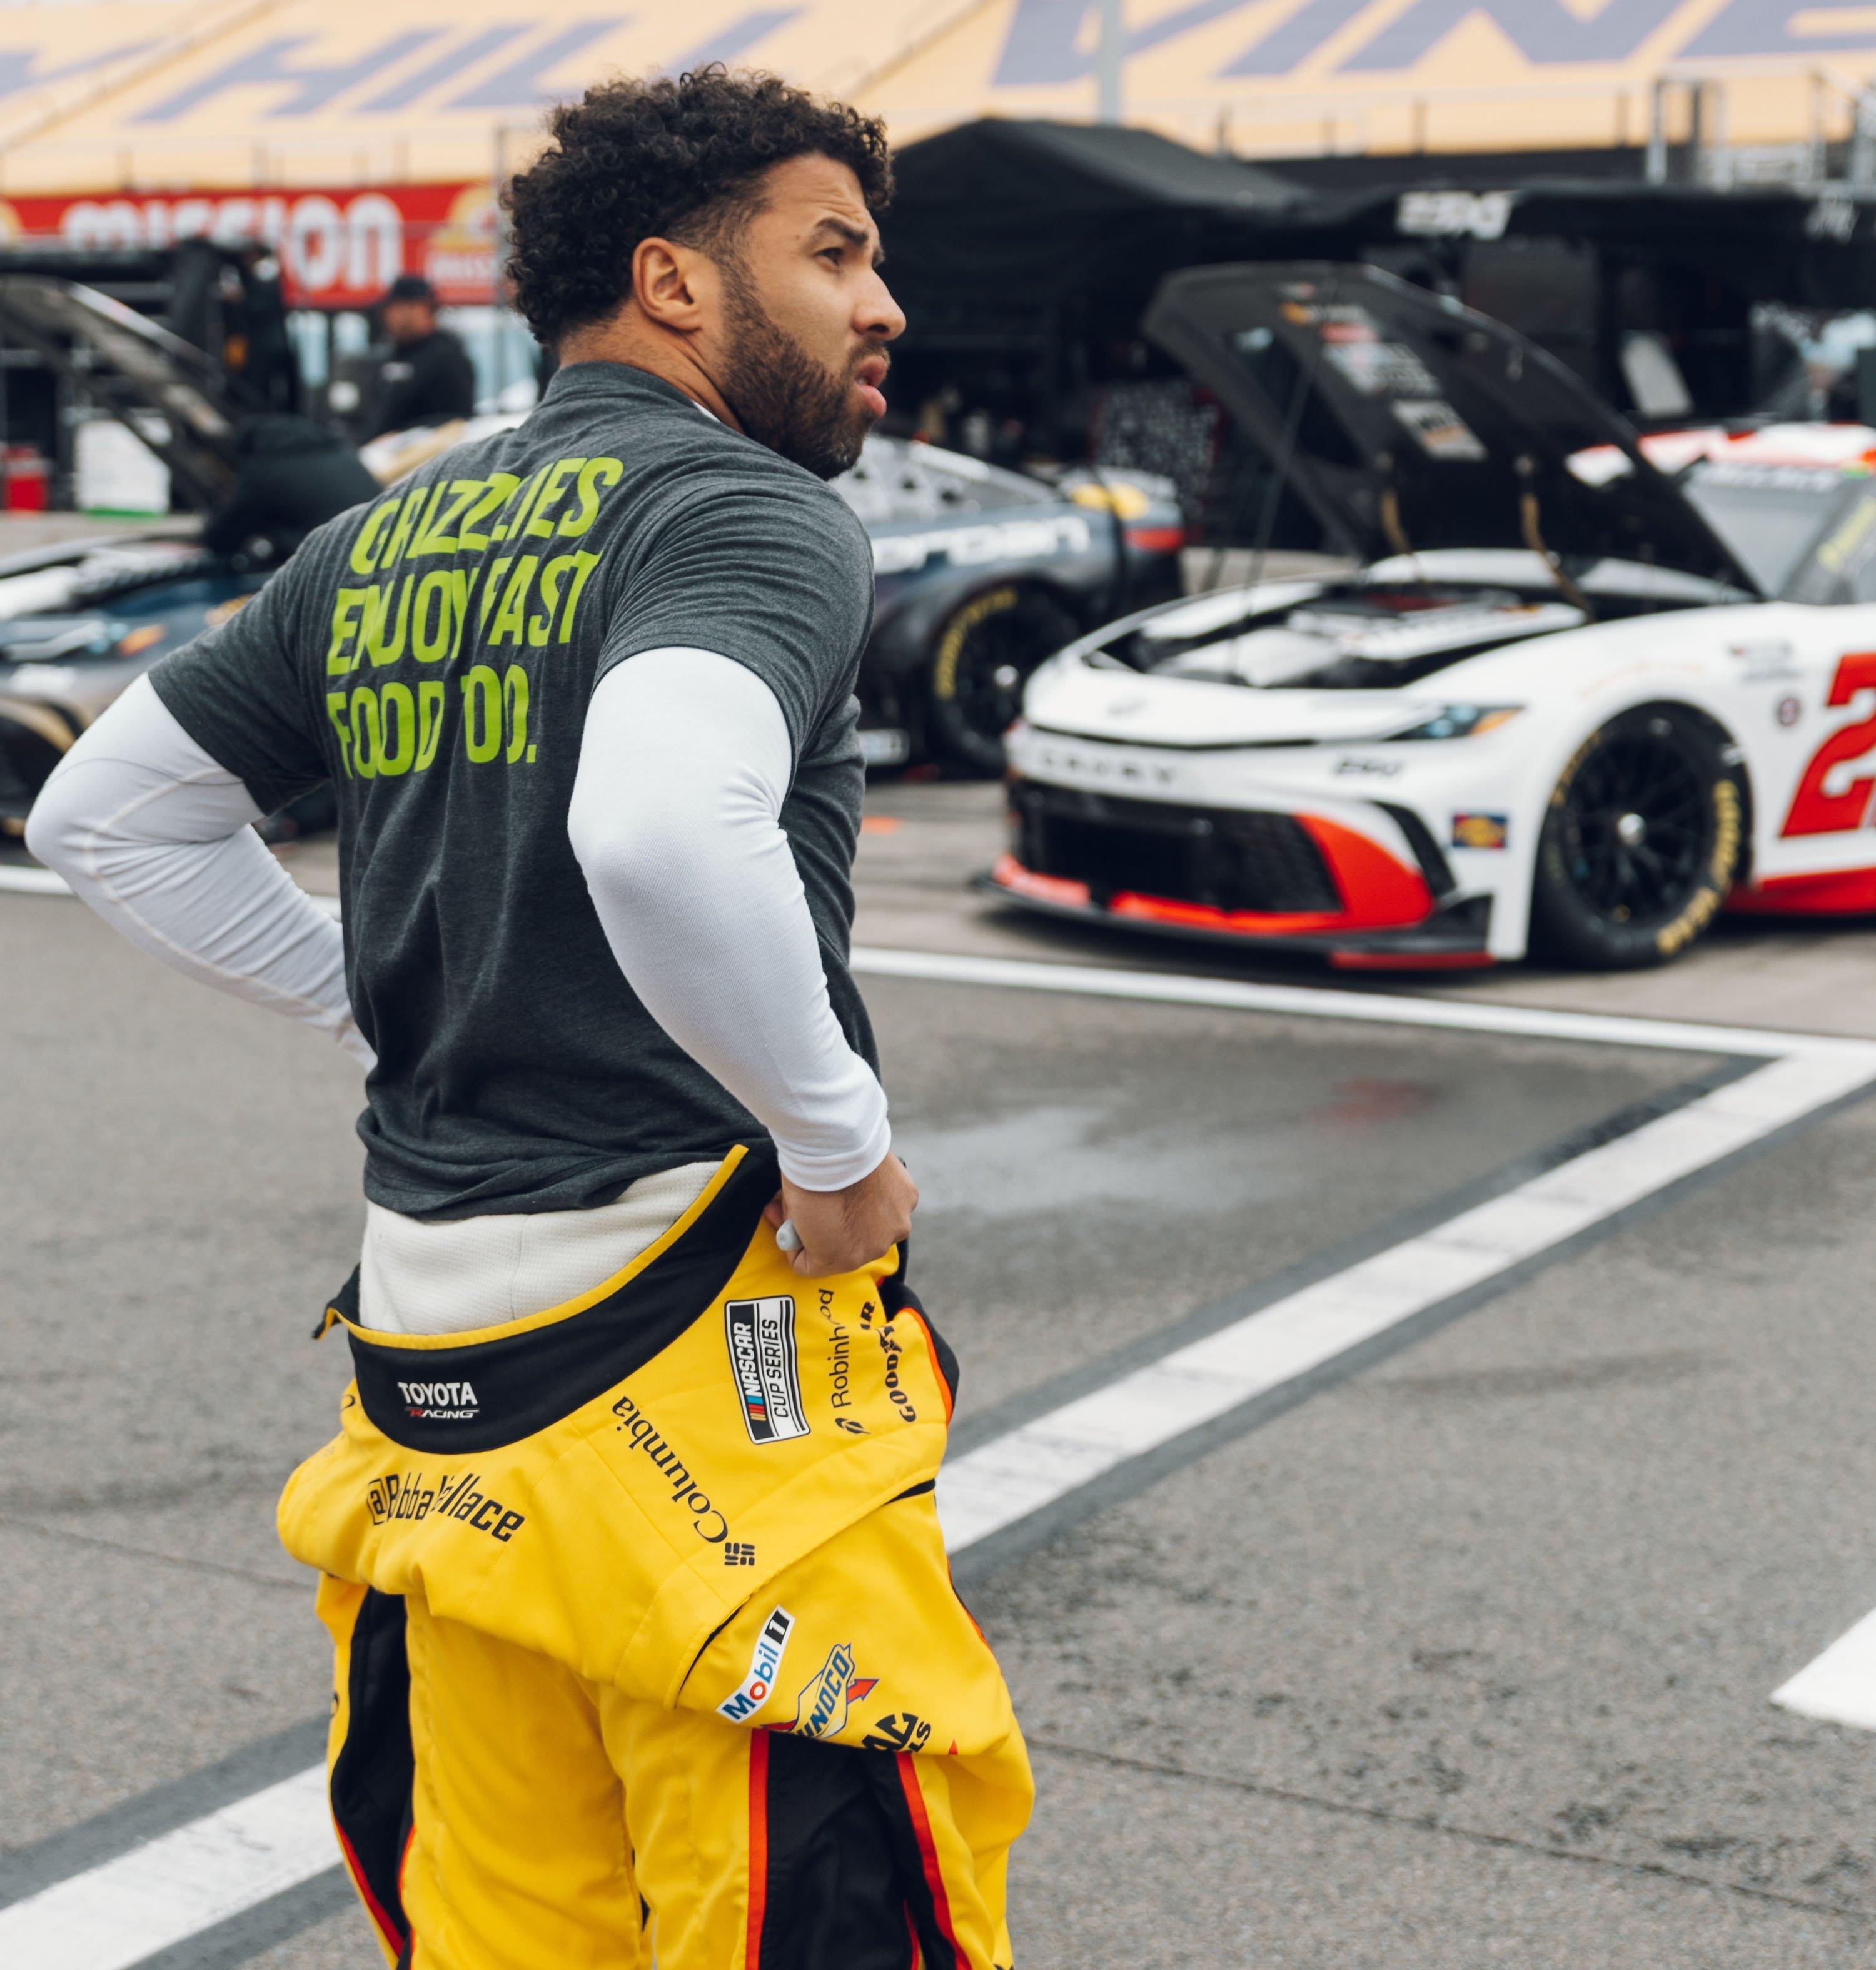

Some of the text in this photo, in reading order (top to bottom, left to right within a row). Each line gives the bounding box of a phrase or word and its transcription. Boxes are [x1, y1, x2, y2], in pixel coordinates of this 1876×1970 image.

[351, 457, 624, 575] GRIZZLIES
[326, 550, 604, 676] ENJOY FAST
[326, 664, 537, 779] FOOD OO.
[397, 1382, 478, 1407] TOYOTA
[733, 1321, 763, 1398] NASCAR
[761, 1318, 789, 1418] CUP SERIES
[405, 1407, 480, 1419] RACING
[612, 1395, 729, 1543] Columbia
[722, 1642, 779, 1720] Mobil
